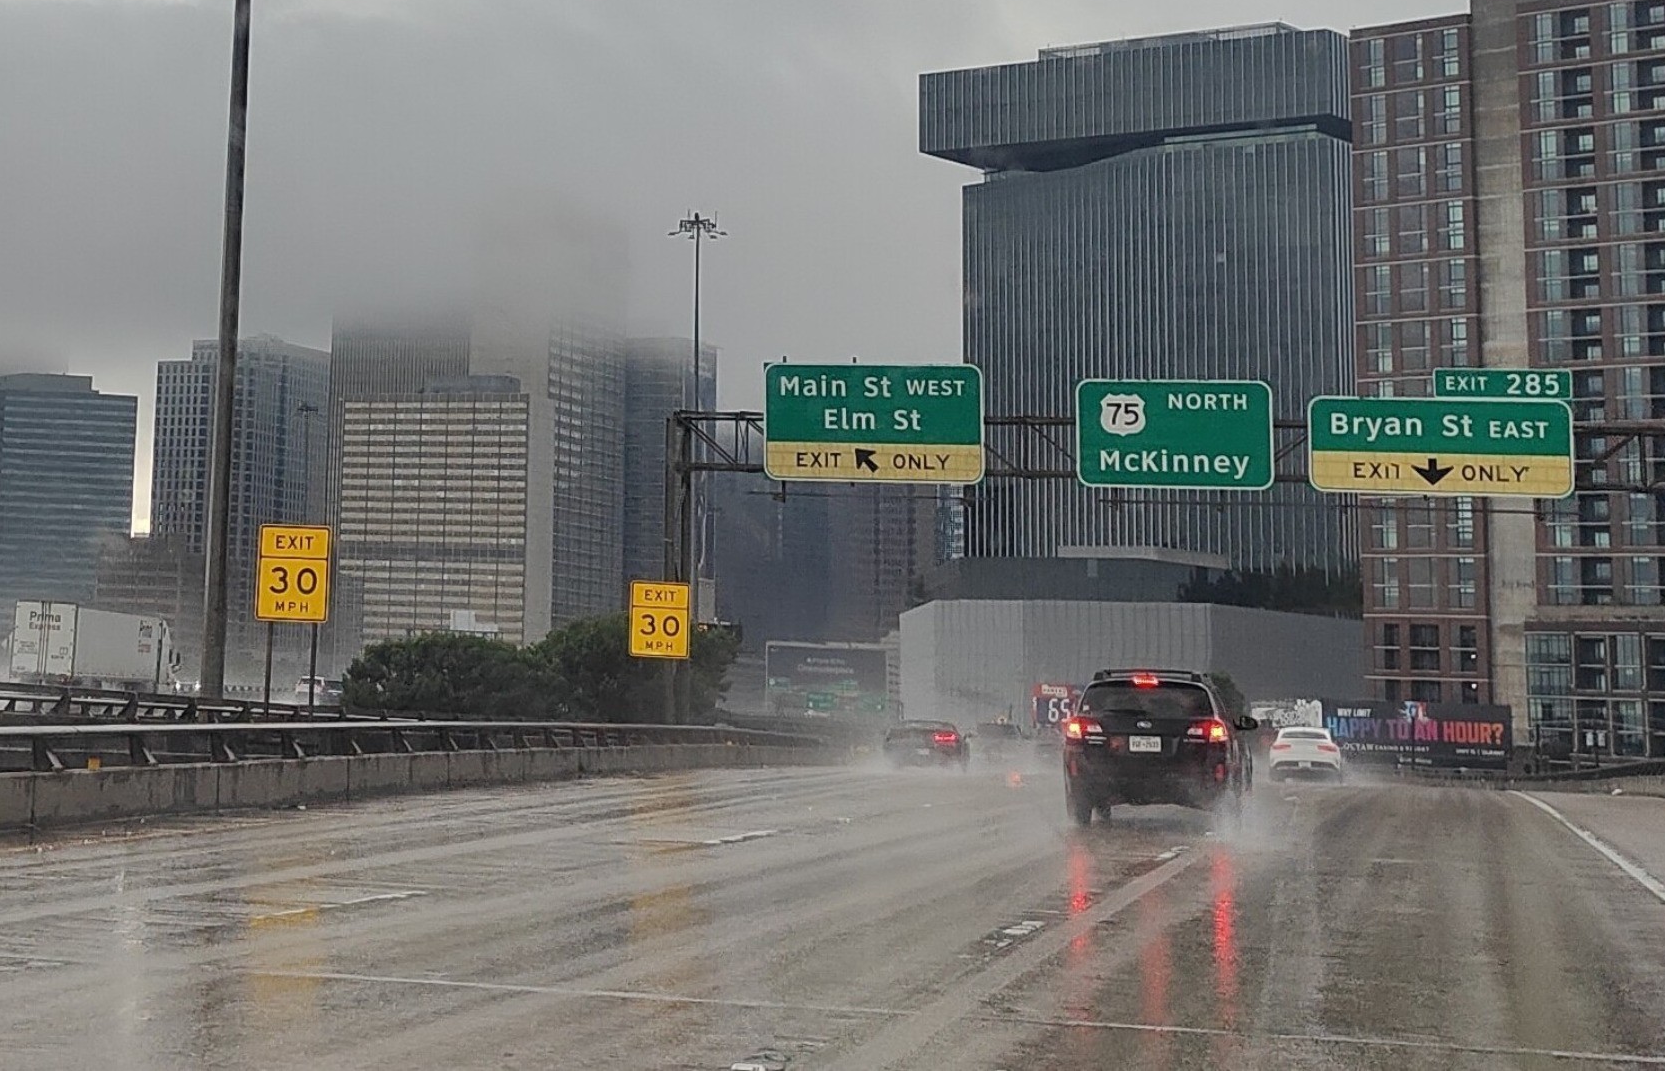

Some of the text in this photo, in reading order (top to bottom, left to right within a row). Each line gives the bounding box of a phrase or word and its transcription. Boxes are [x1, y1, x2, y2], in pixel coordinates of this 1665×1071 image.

[780, 374, 966, 398] Main St WEST
[1444, 373, 1560, 396] EXIT 285
[824, 407, 922, 431] Elm St
[1106, 393, 1248, 426] 75 NORTH
[1330, 412, 1549, 441] Bryan St EAST
[796, 452, 950, 470] EXIT ONLY
[1100, 449, 1249, 480] McKinney
[1461, 465, 1530, 482] ONLY
[275, 535, 314, 550] EXIT
[269, 566, 318, 595] 30
[275, 601, 309, 613] MPH
[644, 589, 677, 602] EXIT
[640, 614, 680, 637] 30
[645, 641, 673, 651] MPH
[1326, 716, 1504, 744] HAPPY TO AN HOUR?
